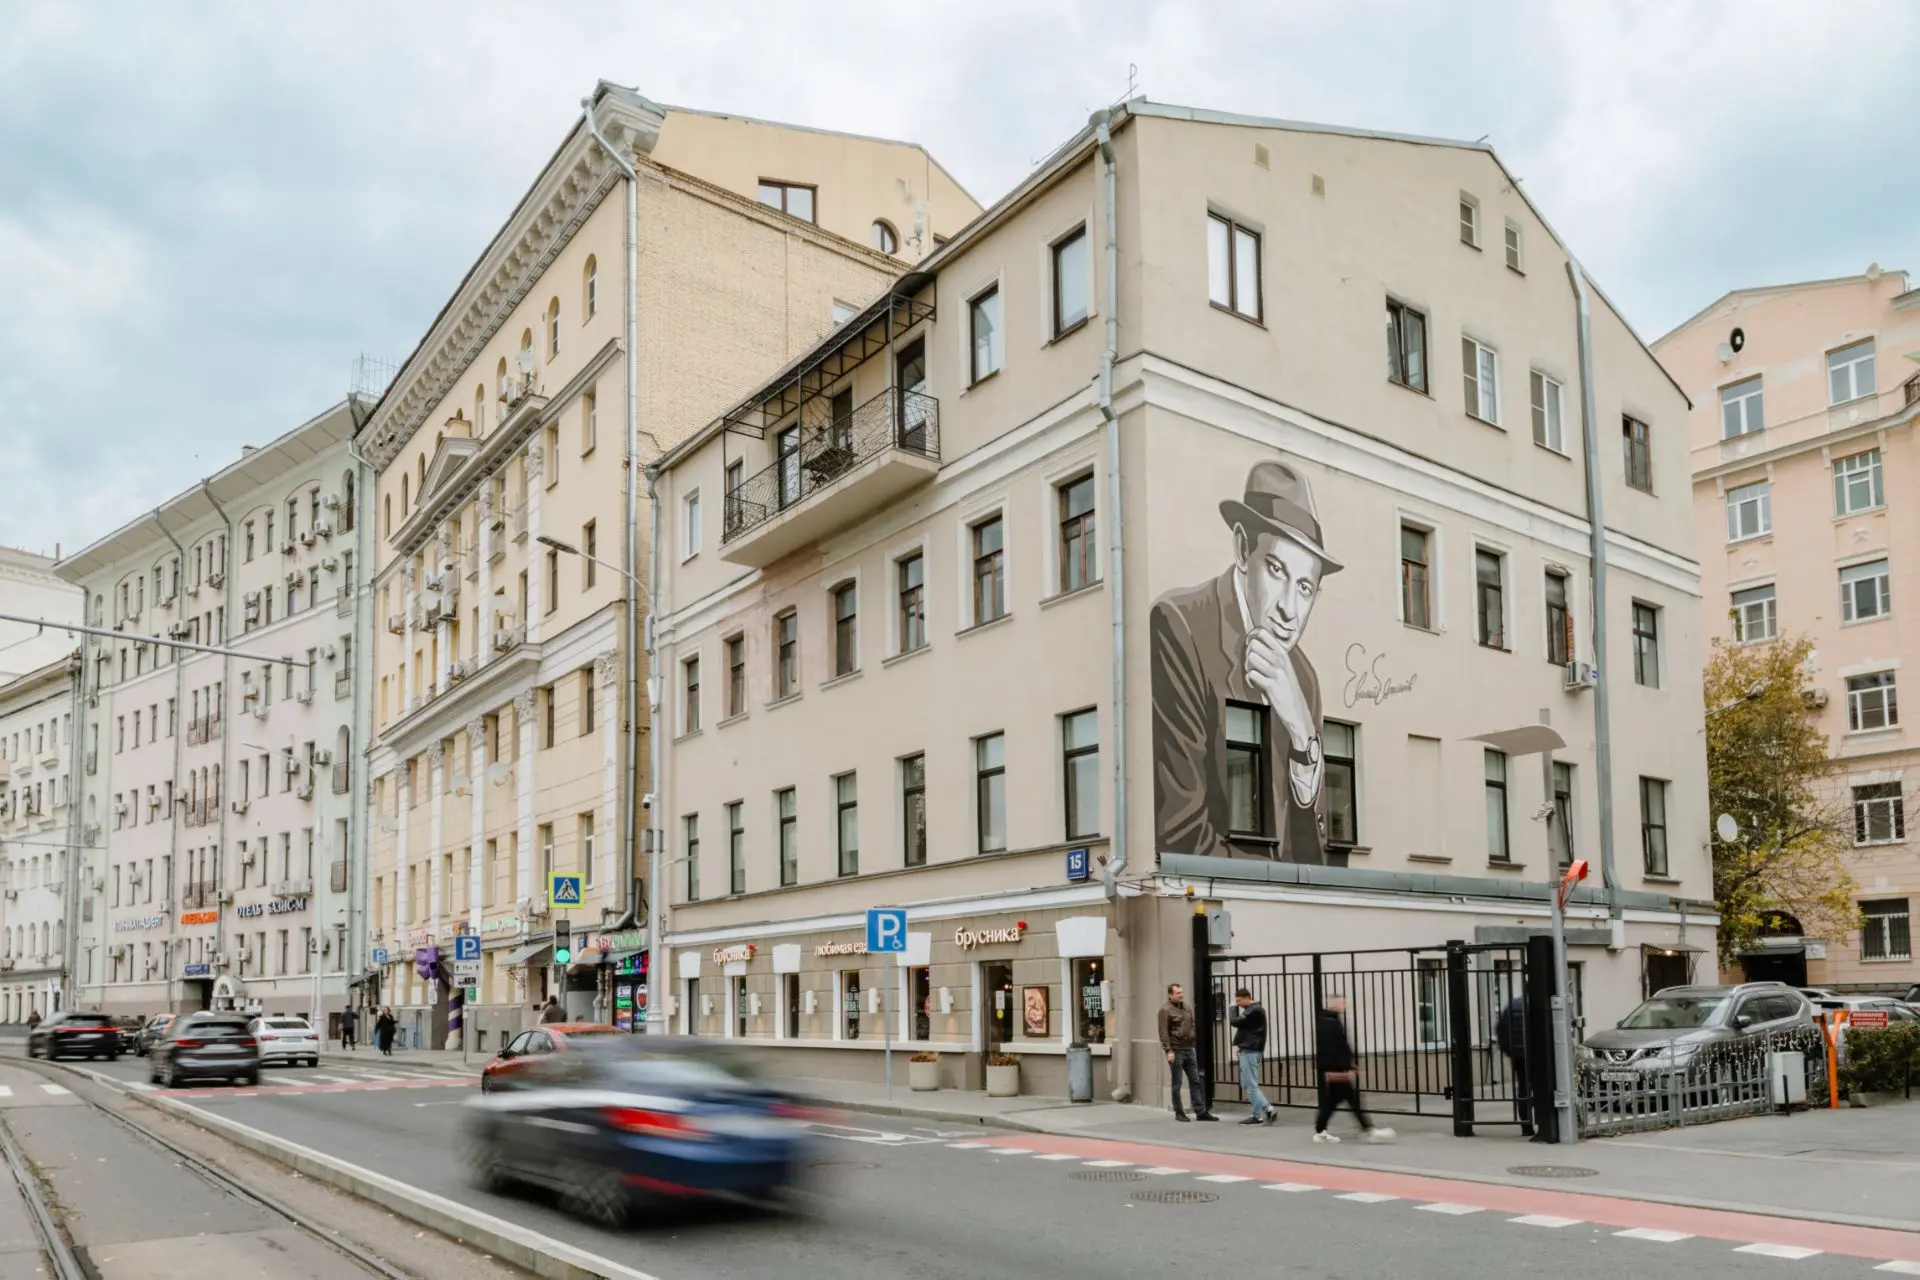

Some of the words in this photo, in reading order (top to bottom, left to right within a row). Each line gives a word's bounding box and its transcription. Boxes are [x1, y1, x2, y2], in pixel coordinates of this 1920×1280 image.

[1069, 854, 1082, 869] 15
[955, 926, 1020, 950] брусника
[713, 947, 752, 966] брусника
[814, 940, 852, 956] любимая
